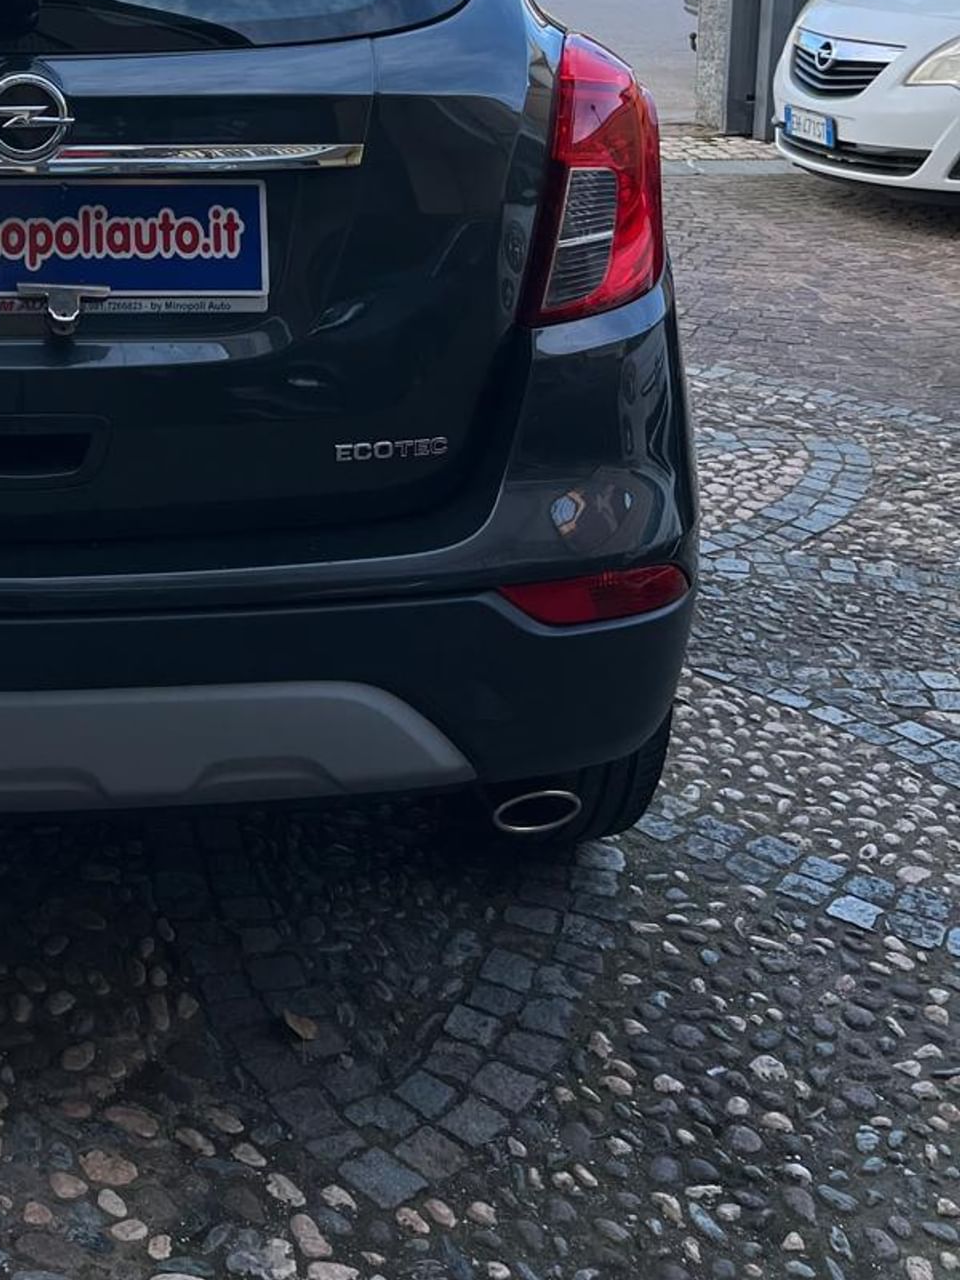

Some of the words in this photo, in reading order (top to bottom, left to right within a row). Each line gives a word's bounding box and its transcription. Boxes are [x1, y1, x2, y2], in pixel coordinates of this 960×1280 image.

[150, 301, 162, 313] by
[164, 301, 206, 312] Minopoli
[208, 301, 232, 310] Auto
[334, 436, 449, 461] ECOTEC
